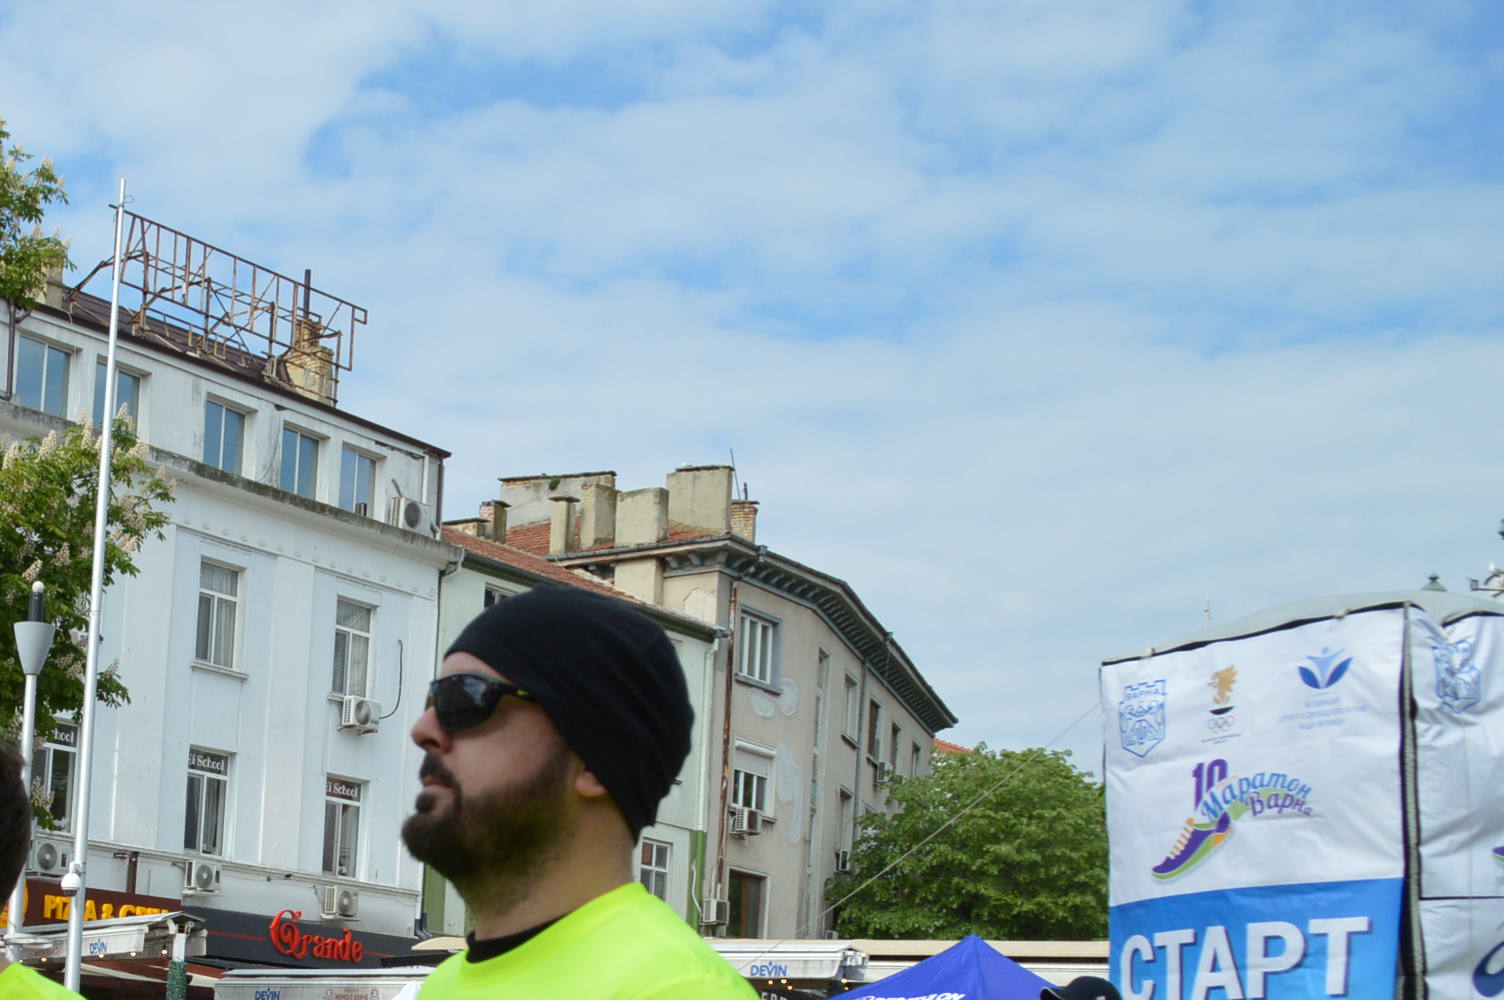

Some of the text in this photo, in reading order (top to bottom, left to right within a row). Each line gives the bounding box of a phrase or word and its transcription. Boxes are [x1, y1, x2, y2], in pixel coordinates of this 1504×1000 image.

[1201, 772, 1312, 822] Маратон
[1246, 791, 1314, 817] Варна
[44, 894, 96, 922] PIZA
[269, 909, 364, 963] Grande
[750, 962, 788, 977] DEVIN
[255, 989, 281, 1000] DEVIN
